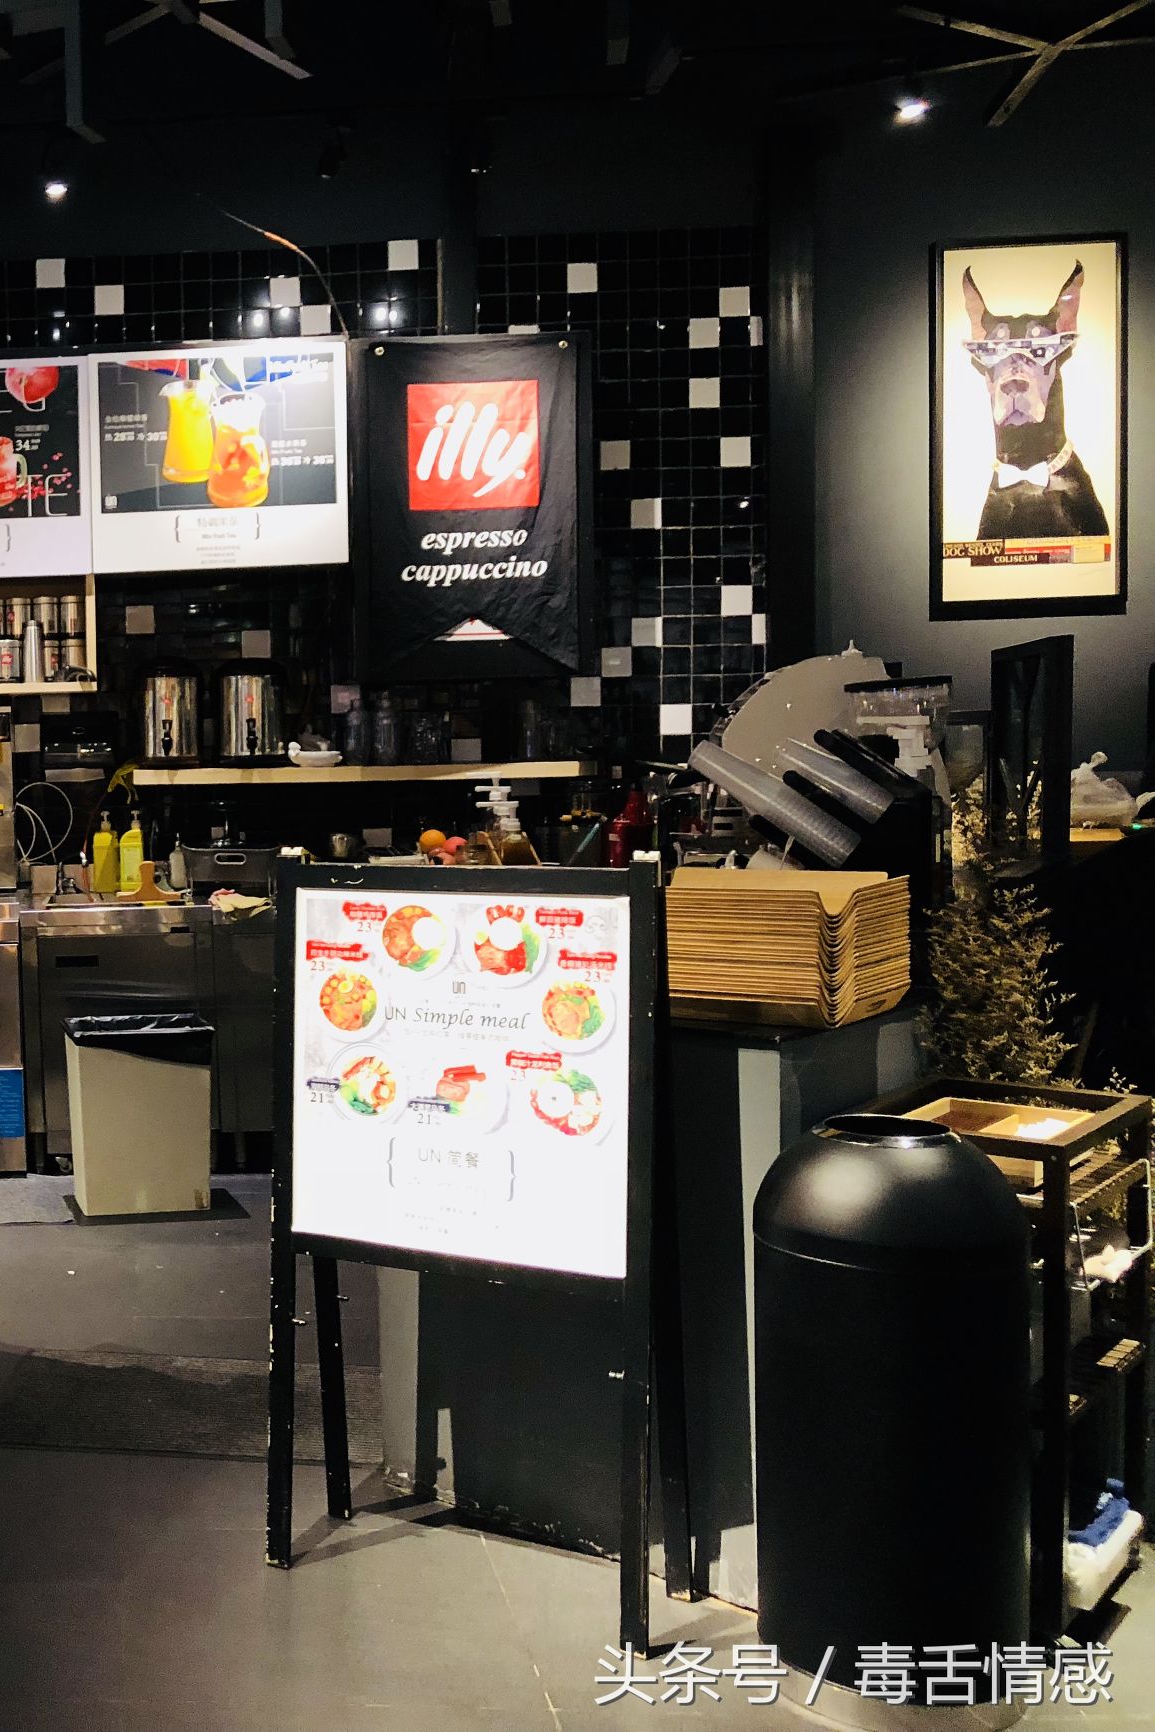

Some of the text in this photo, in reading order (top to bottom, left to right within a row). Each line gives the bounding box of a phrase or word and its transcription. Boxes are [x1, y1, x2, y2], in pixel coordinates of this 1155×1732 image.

[416, 400, 532, 497] illy
[421, 529, 528, 555] espresso
[967, 545, 1003, 556] SHOW
[994, 554, 1038, 563] COLISEUM
[401, 556, 548, 588] cappuccino
[357, 922, 372, 932] 23
[548, 928, 565, 939] 23
[310, 961, 325, 971] 23
[584, 971, 601, 982] 23
[384, 1006, 531, 1029] UN Simple meal
[310, 1092, 324, 1102] 21
[417, 1114, 431, 1125] 21
